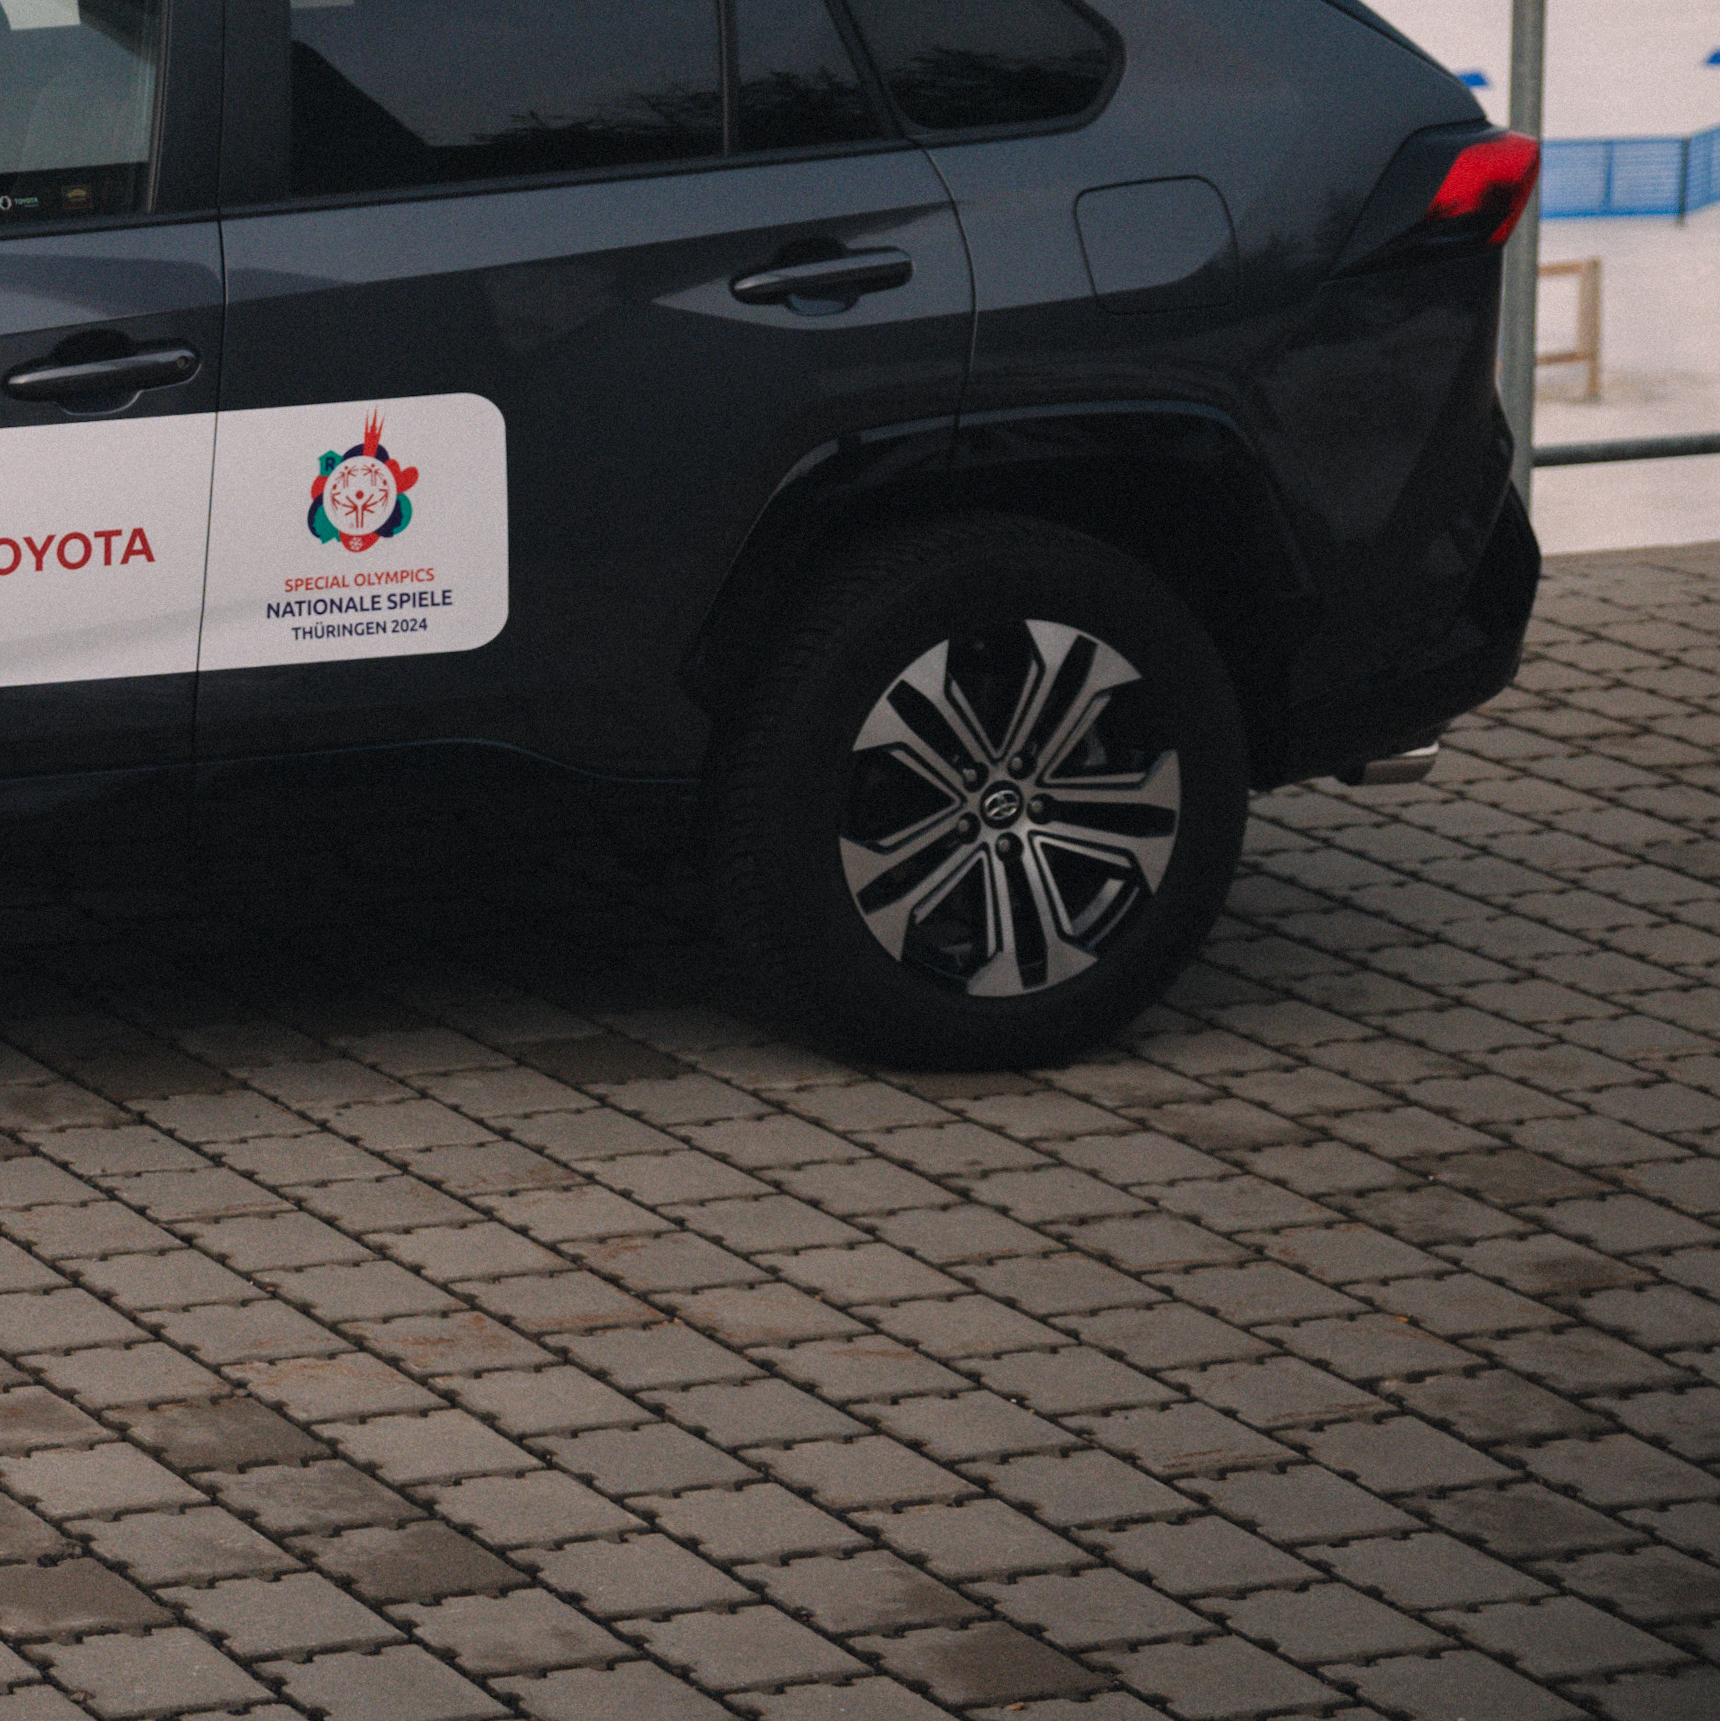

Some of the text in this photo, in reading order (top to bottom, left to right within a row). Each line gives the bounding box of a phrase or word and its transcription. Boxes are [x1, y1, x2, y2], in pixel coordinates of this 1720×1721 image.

[284, 567, 436, 593] SPECIAL OLYMPICS
[266, 589, 454, 620] NATIONALE SPIELE
[291, 617, 428, 641] THÜRINGEN 2024
